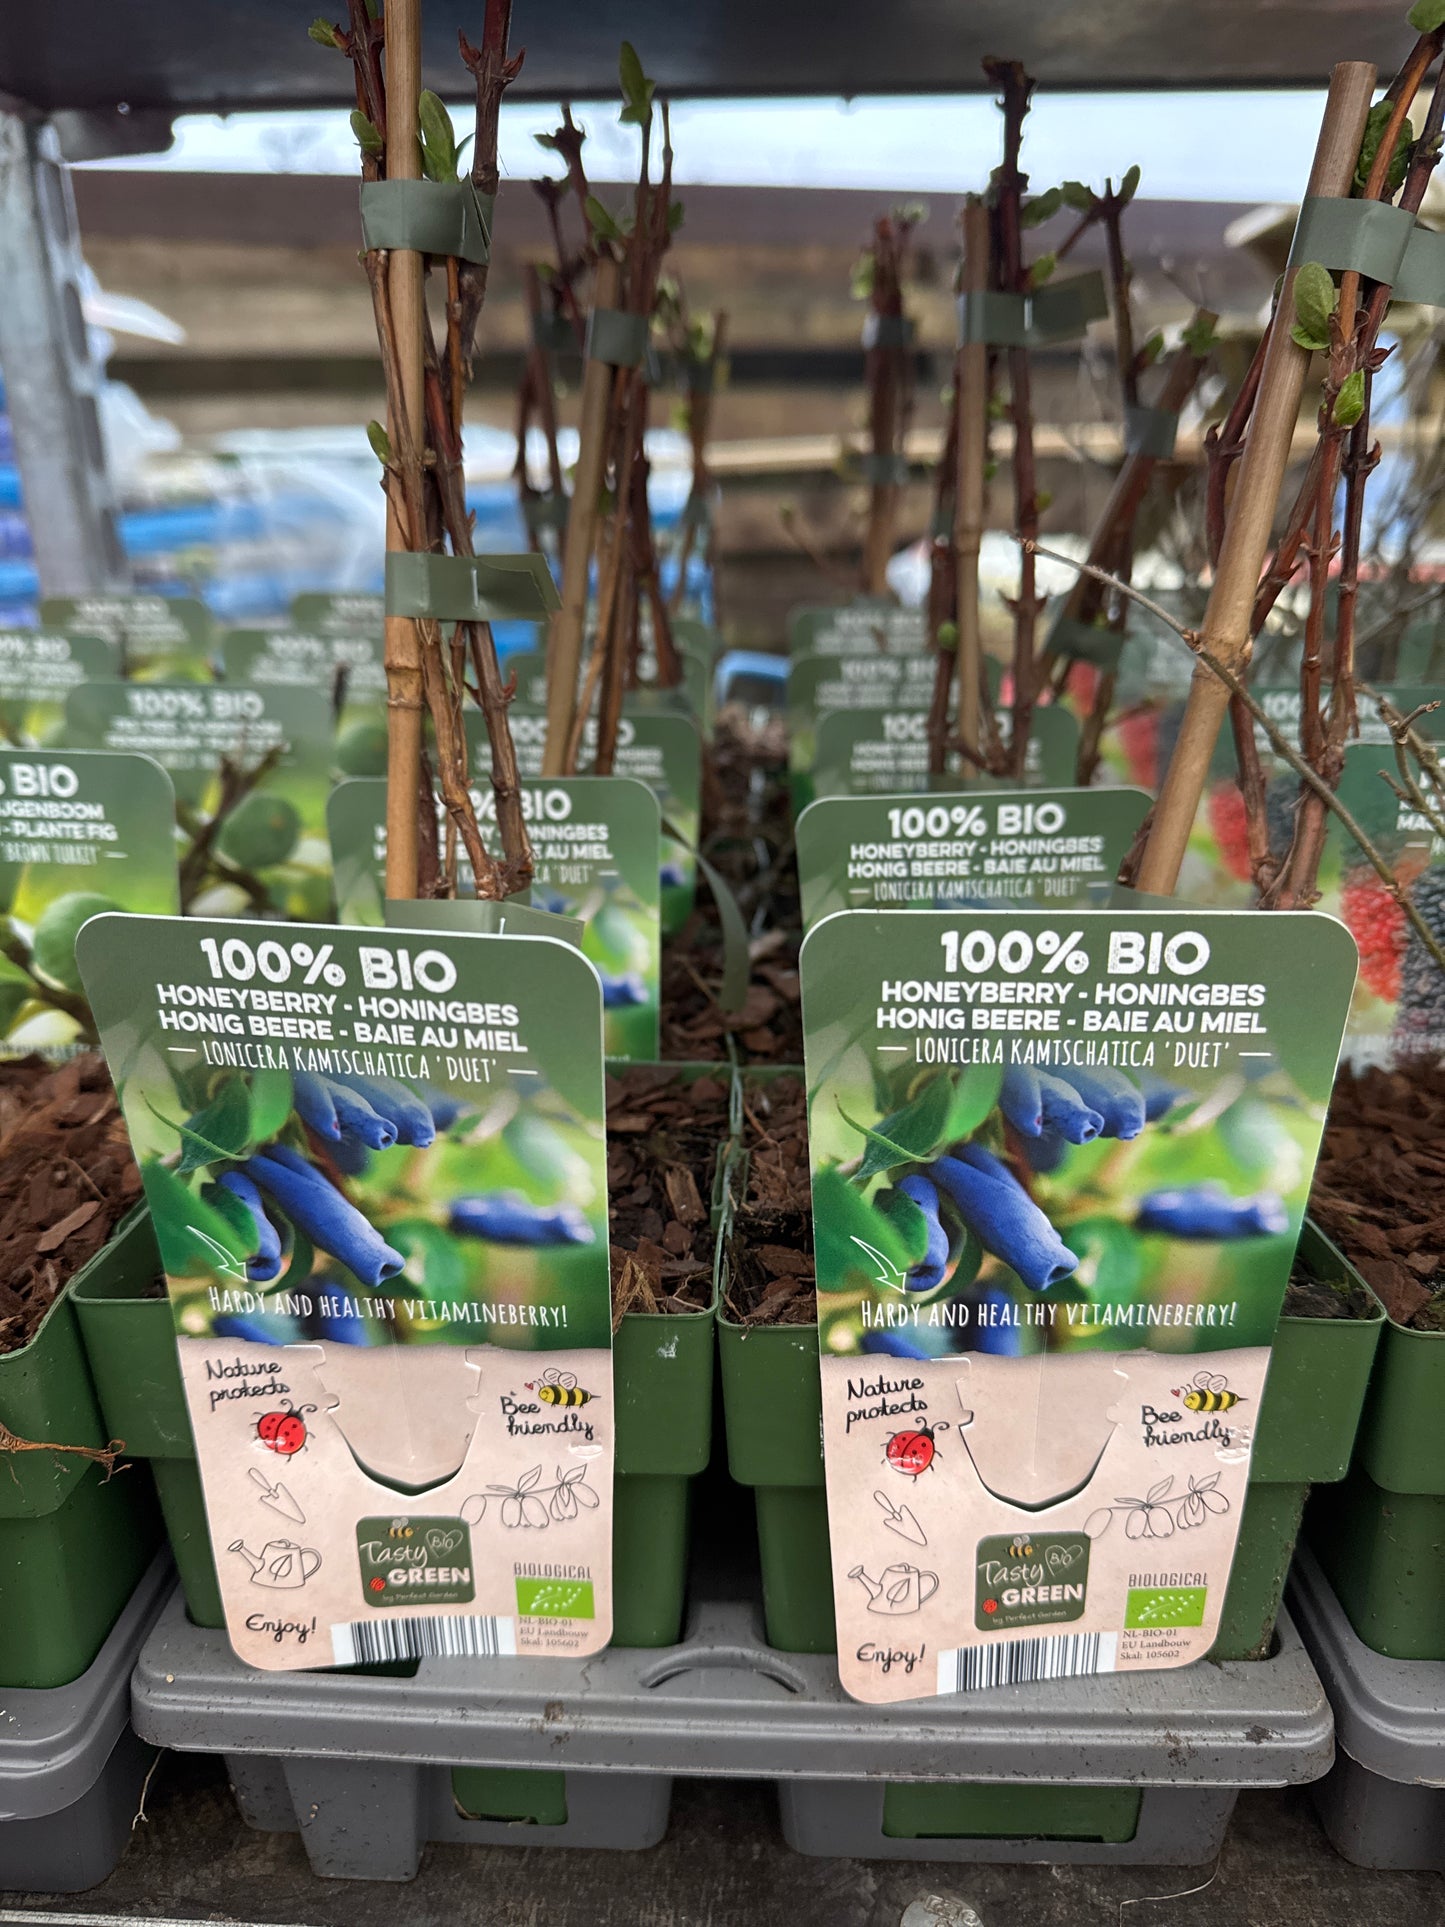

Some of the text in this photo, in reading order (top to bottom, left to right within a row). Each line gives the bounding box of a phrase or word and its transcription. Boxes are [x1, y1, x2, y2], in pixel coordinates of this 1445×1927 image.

[127, 689, 265, 719] 100% BIO
[11, 763, 79, 797] BIO
[888, 802, 1066, 838] 100% BIO
[545, 844, 571, 859] AU
[572, 844, 613, 860] MIEL
[851, 841, 977, 860] HONEYBERRY
[990, 836, 1104, 856] HONINGBES
[848, 862, 907, 878] HONIG
[911, 860, 970, 877] BEERE
[984, 858, 1027, 874] BAIE
[1029, 857, 1057, 873] AU
[1060, 855, 1106, 872] MIEL
[200, 938, 457, 993] 100% BIO
[941, 929, 1210, 976] 100% BIO
[156, 984, 336, 1016] HONEYBERRY
[358, 996, 519, 1026] HONINGBES
[882, 981, 1074, 1004] HONEYBERRY
[1095, 983, 1266, 1007] HONINGBES
[159, 1010, 245, 1035] HONIG
[249, 1016, 334, 1041] BEERE
[354, 1022, 416, 1047] BAIE
[421, 1027, 458, 1048] AU
[465, 1030, 528, 1052] MIEL
[877, 1007, 965, 1030] HONIG
[972, 1009, 1060, 1031] BEERE
[1083, 1010, 1147, 1032] BAIE
[1152, 1011, 1194, 1033] AU
[1201, 1012, 1267, 1033] MIEL
[202, 1040, 496, 1083] LONICERA KAMTSCHATICA 'DUET'
[915, 1037, 1230, 1068] LONICERA KAMTSCHATICA 'DUET'
[209, 1287, 568, 1328] HARDY AND HEALTHY VITAMINEBERRY!
[861, 1301, 1238, 1328] HARDY AND HEALTHY VITAMINEBERRY!
[206, 1358, 282, 1381] Nature
[210, 1376, 291, 1411] protects
[847, 1375, 924, 1400] Nature
[501, 1395, 541, 1415] Bee
[846, 1393, 928, 1433] protects
[1141, 1405, 1182, 1425] Bee
[506, 1412, 594, 1441] friendly
[1144, 1419, 1232, 1449] friendly
[360, 1541, 428, 1568] Tasty
[1050, 1552, 1072, 1566] BIO
[388, 1567, 470, 1584] GREEN
[514, 1562, 591, 1579] BIOLOGICAL
[978, 1560, 1043, 1587] Tasty
[1128, 1573, 1208, 1587] BIOLOGICAL
[1001, 1583, 1083, 1606] GREEN
[246, 1614, 318, 1643] Enjoy!
[520, 1627, 588, 1637] EU Landbouw
[1123, 1629, 1177, 1638] NL-BIO-01
[1121, 1650, 1180, 1660] Skal: 105602
[1122, 1639, 1191, 1649] EU Landbouw
[856, 1643, 926, 1674] Enjoy!
